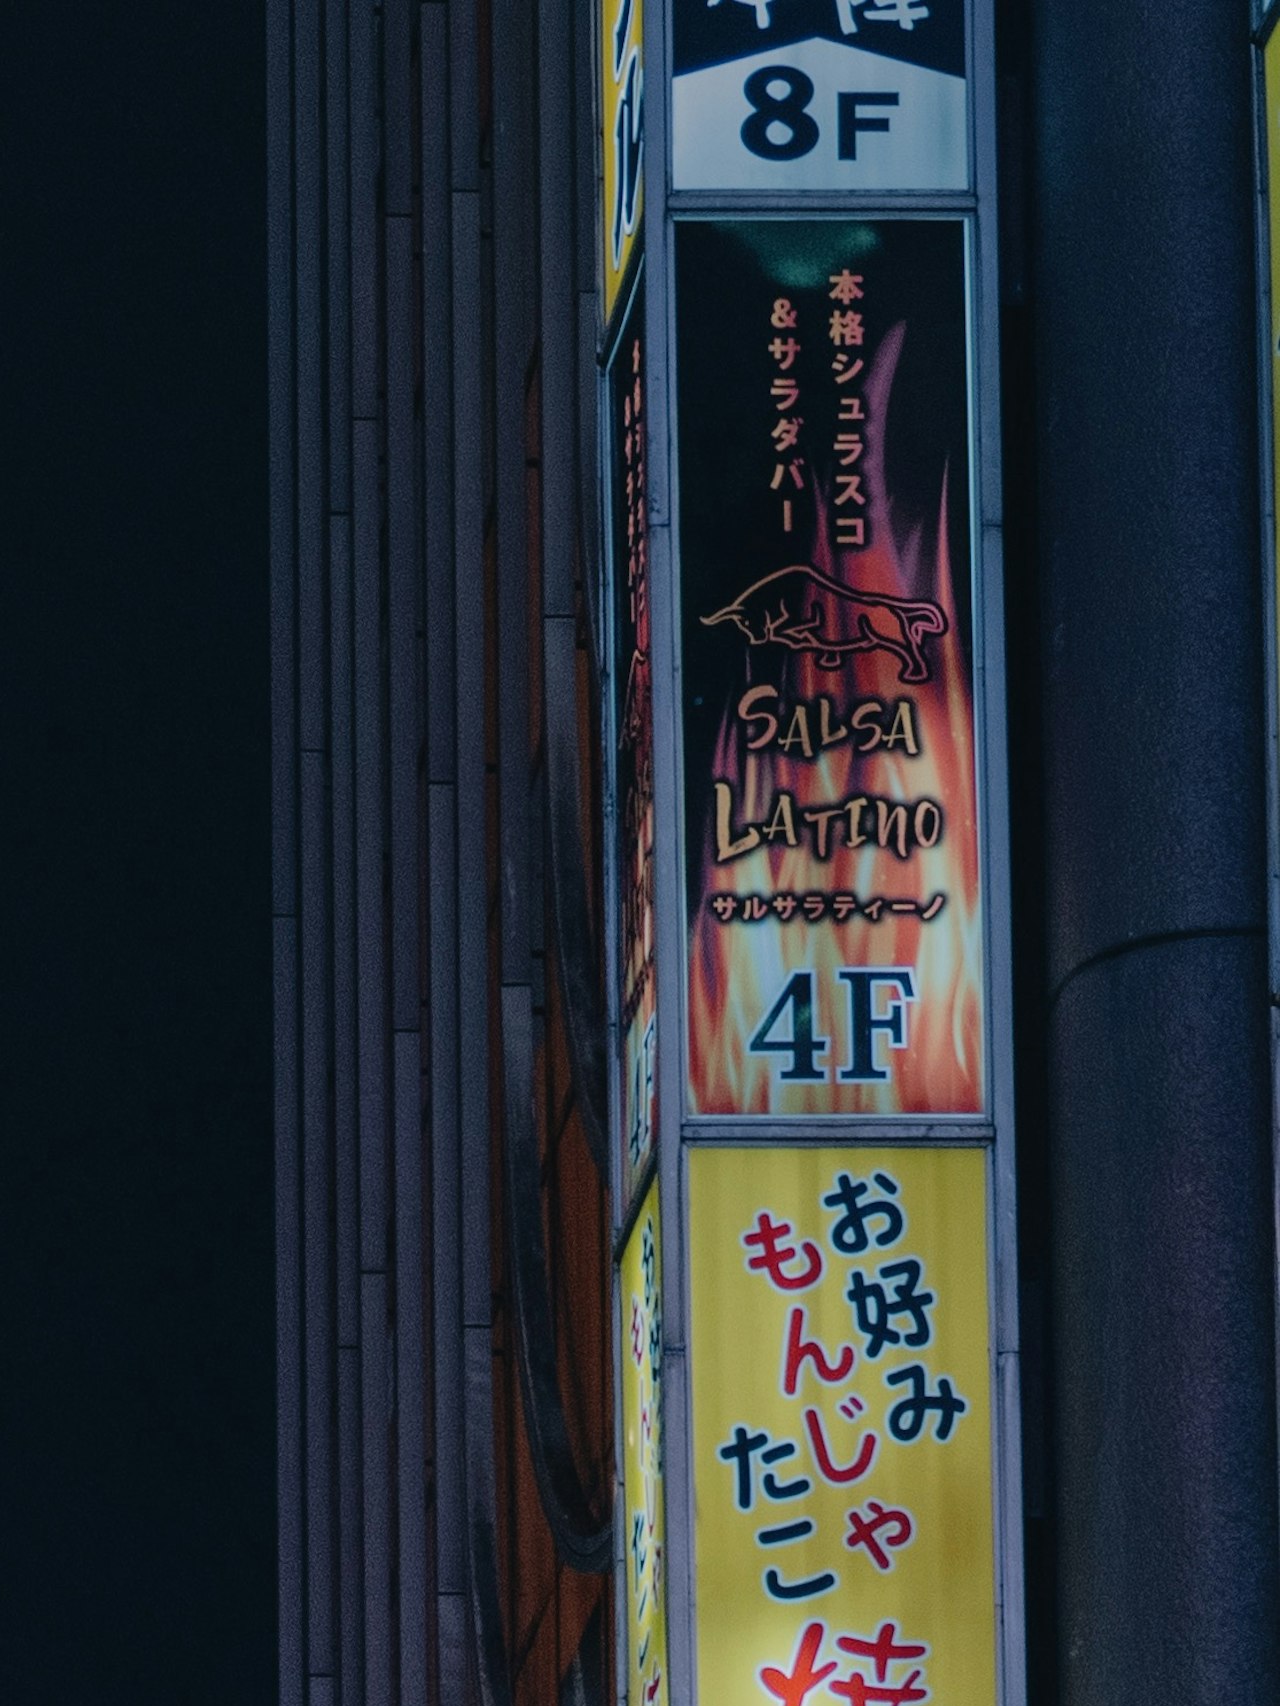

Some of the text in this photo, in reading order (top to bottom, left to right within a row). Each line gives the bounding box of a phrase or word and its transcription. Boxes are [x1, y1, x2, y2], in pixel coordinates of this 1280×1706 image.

[740, 64, 900, 161] 8F
[769, 298, 802, 532] &サラダバー
[829, 269, 865, 546] 本格シュラスコ
[713, 894, 944, 919] サルサラティーノ
[749, 968, 918, 1083] 4F
[743, 1212, 915, 1570] もんじゃ
[824, 1172, 966, 1442] お好み
[720, 1427, 836, 1599] たこ
